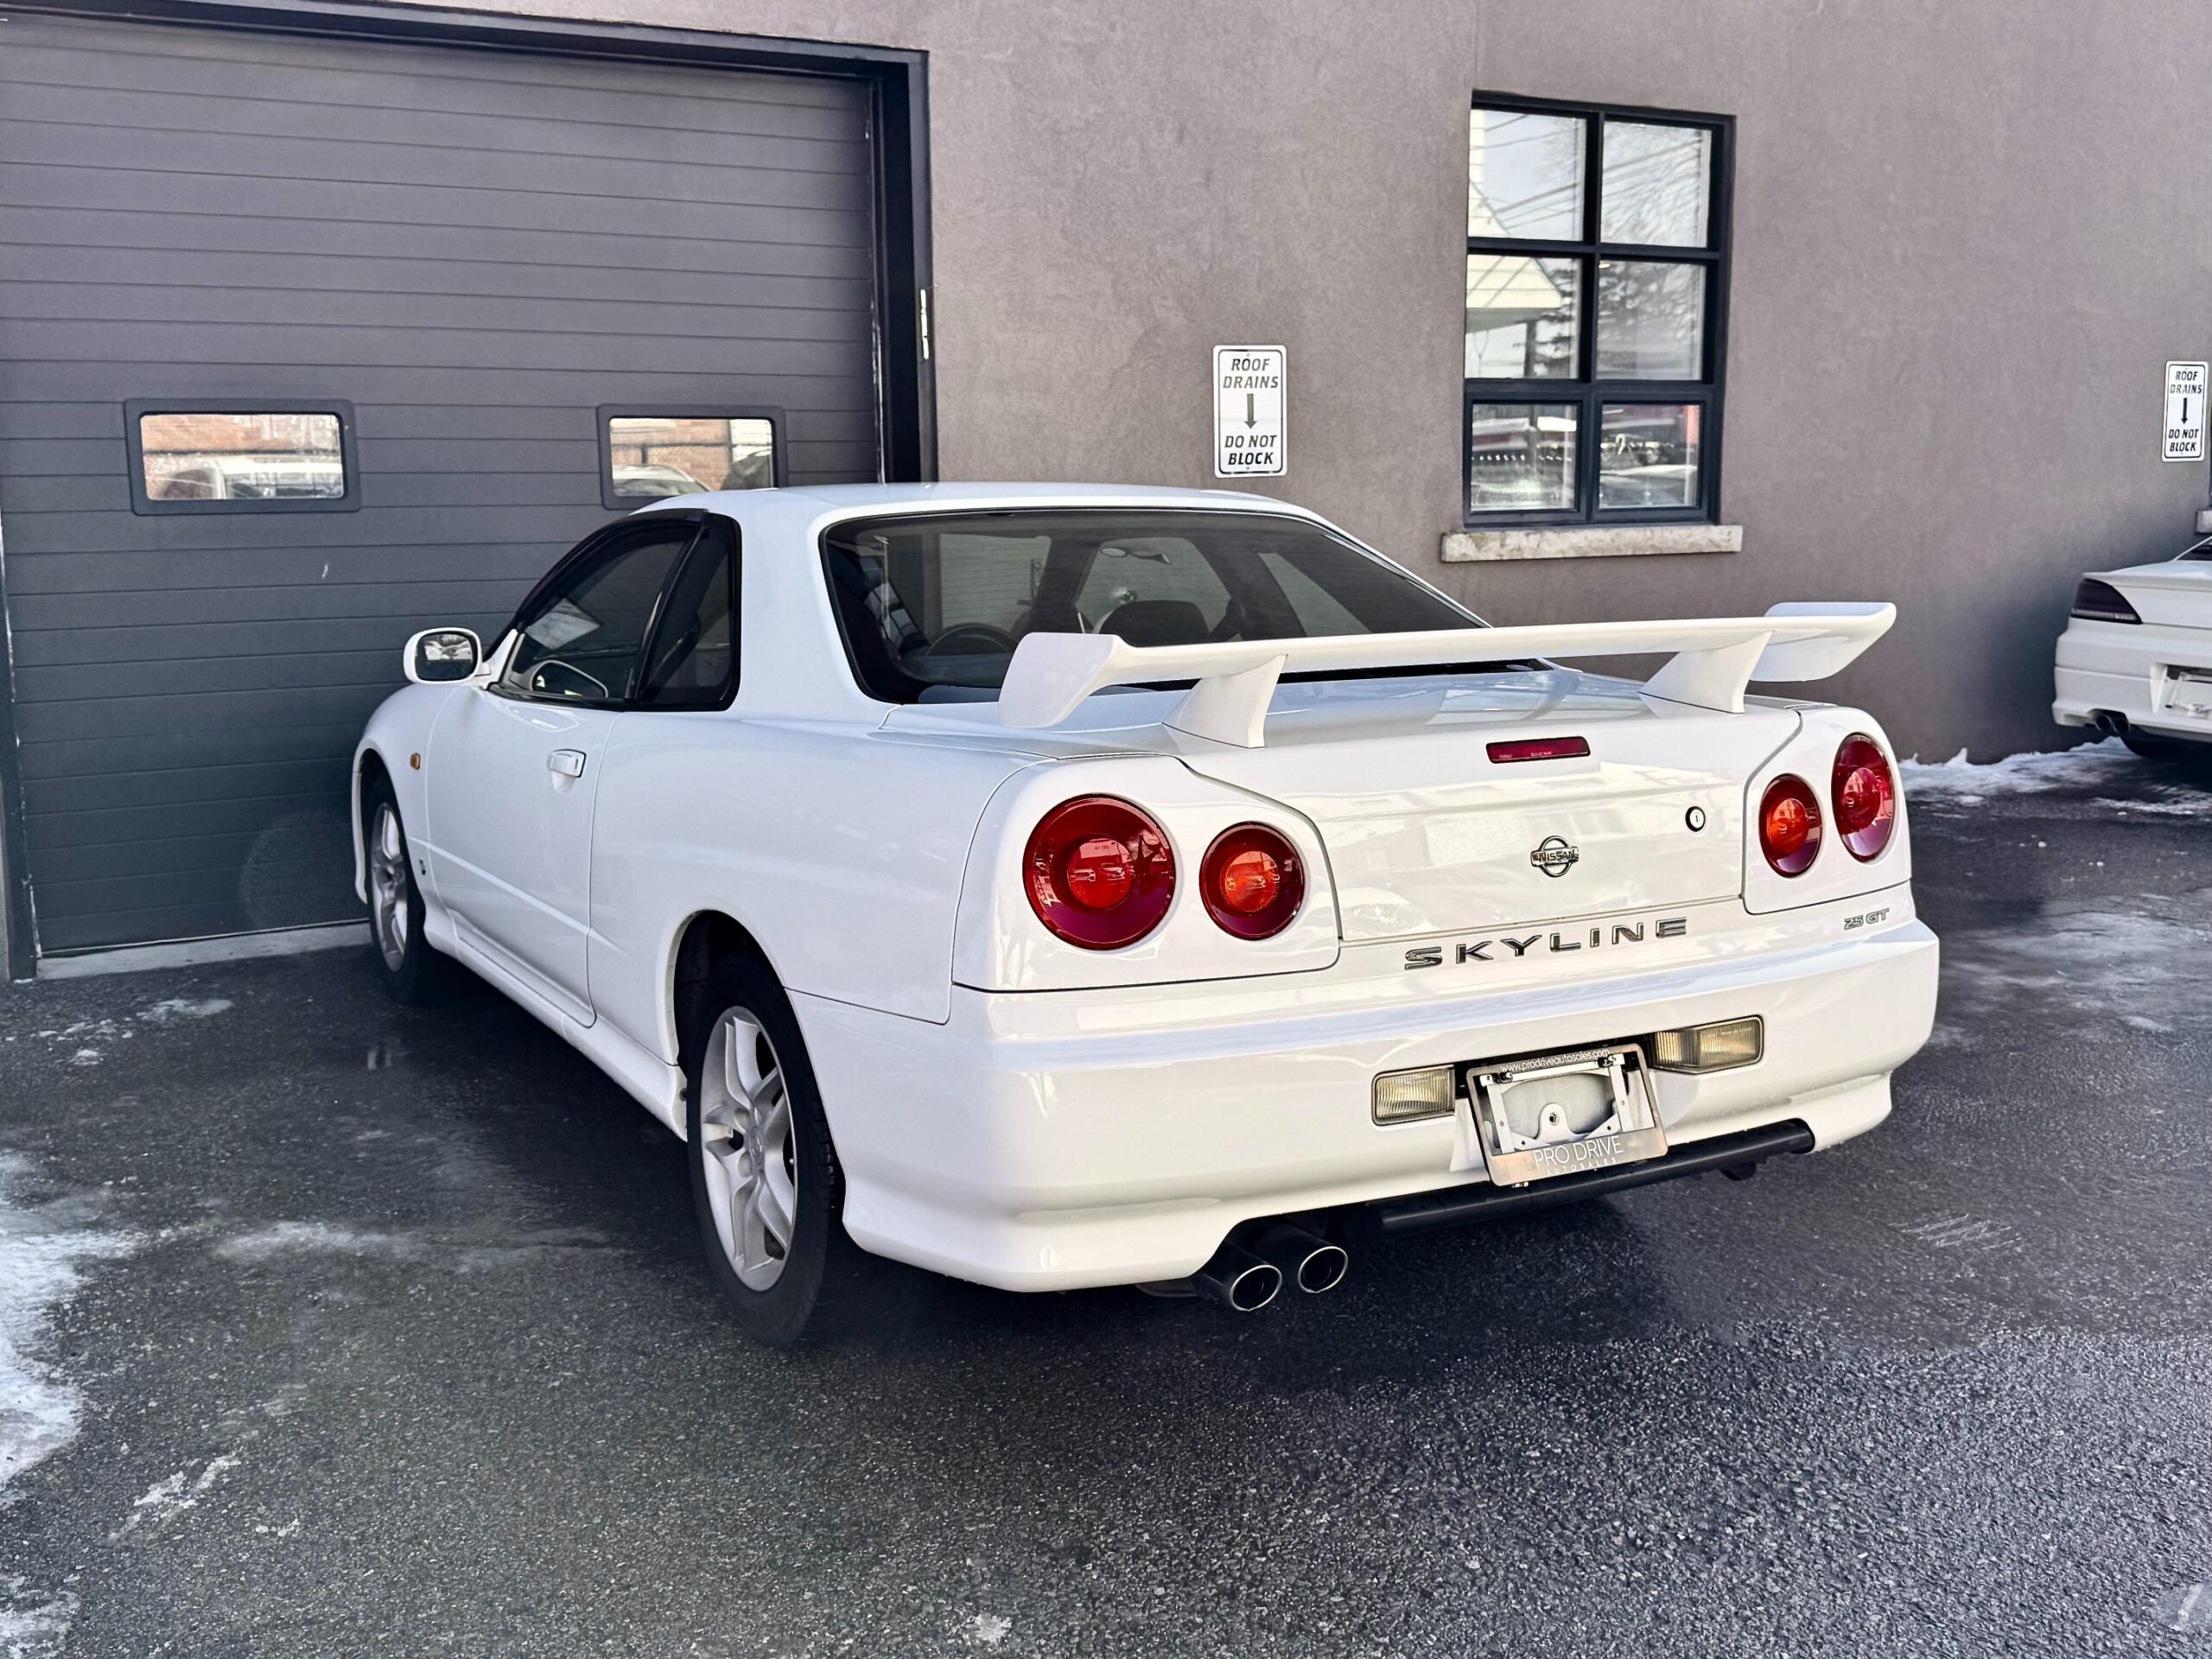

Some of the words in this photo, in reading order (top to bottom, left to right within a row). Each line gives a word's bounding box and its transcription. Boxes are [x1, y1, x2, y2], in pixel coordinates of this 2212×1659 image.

[1231, 359, 1270, 372] ROOF
[1223, 376, 1279, 389] DRAINS
[2175, 371, 2198, 381] ROOF
[2170, 385, 2202, 395] DRAINS
[2168, 429, 2180, 439] DO
[2182, 429, 2199, 439] NOT
[1224, 435, 1244, 448] DO
[1249, 435, 1277, 448] NOT
[2170, 442, 2196, 452] BLOCK
[1228, 452, 1274, 466] BLOCK
[1539, 849, 1574, 862] NISSAN
[1404, 916, 1688, 971] SKYLINE
[1500, 1049, 1610, 1072] www.prodriveautosales.com
[1533, 1145, 1570, 1168] PRO
[1573, 1135, 1624, 1161] DRIVE
[1547, 1157, 1618, 1176] AUTOSALES
